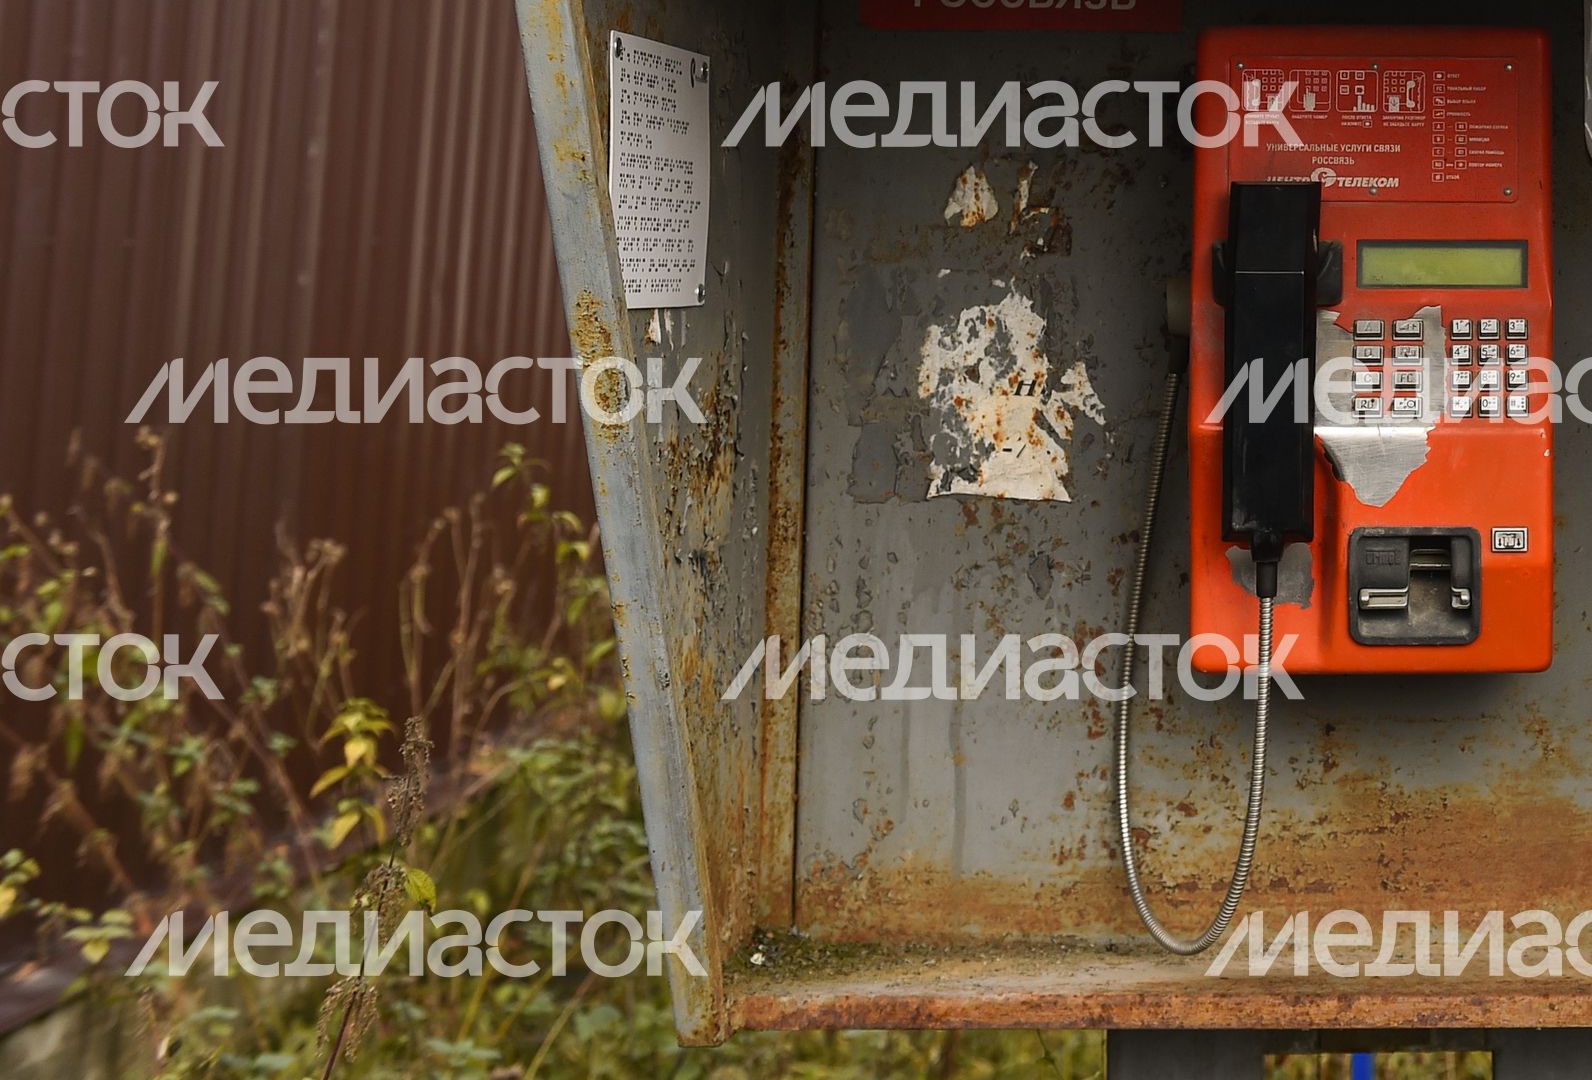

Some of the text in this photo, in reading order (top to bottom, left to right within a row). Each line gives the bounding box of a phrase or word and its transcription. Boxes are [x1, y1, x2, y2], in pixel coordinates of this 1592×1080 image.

[1340, 144, 1372, 152] УСЛУГИ
[1373, 144, 1401, 153] СВЯЗИ
[1312, 156, 1355, 165] РОССВЯЗЬ
